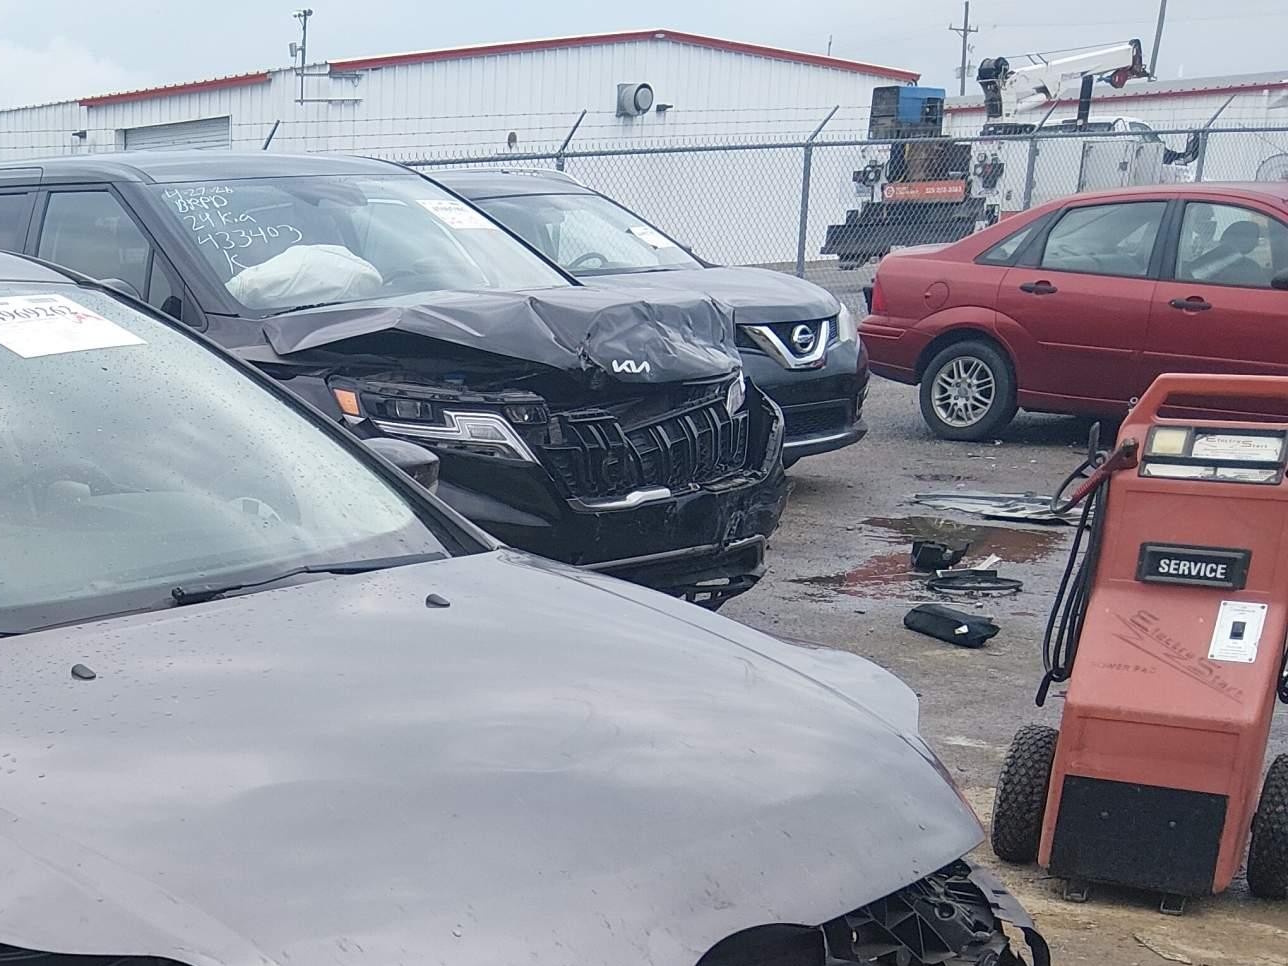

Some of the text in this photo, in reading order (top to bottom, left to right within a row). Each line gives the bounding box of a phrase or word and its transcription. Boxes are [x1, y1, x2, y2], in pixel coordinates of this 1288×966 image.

[184, 212, 215, 231] 24
[197, 224, 303, 250] 433403
[1158, 558, 1227, 579] SERVICE
